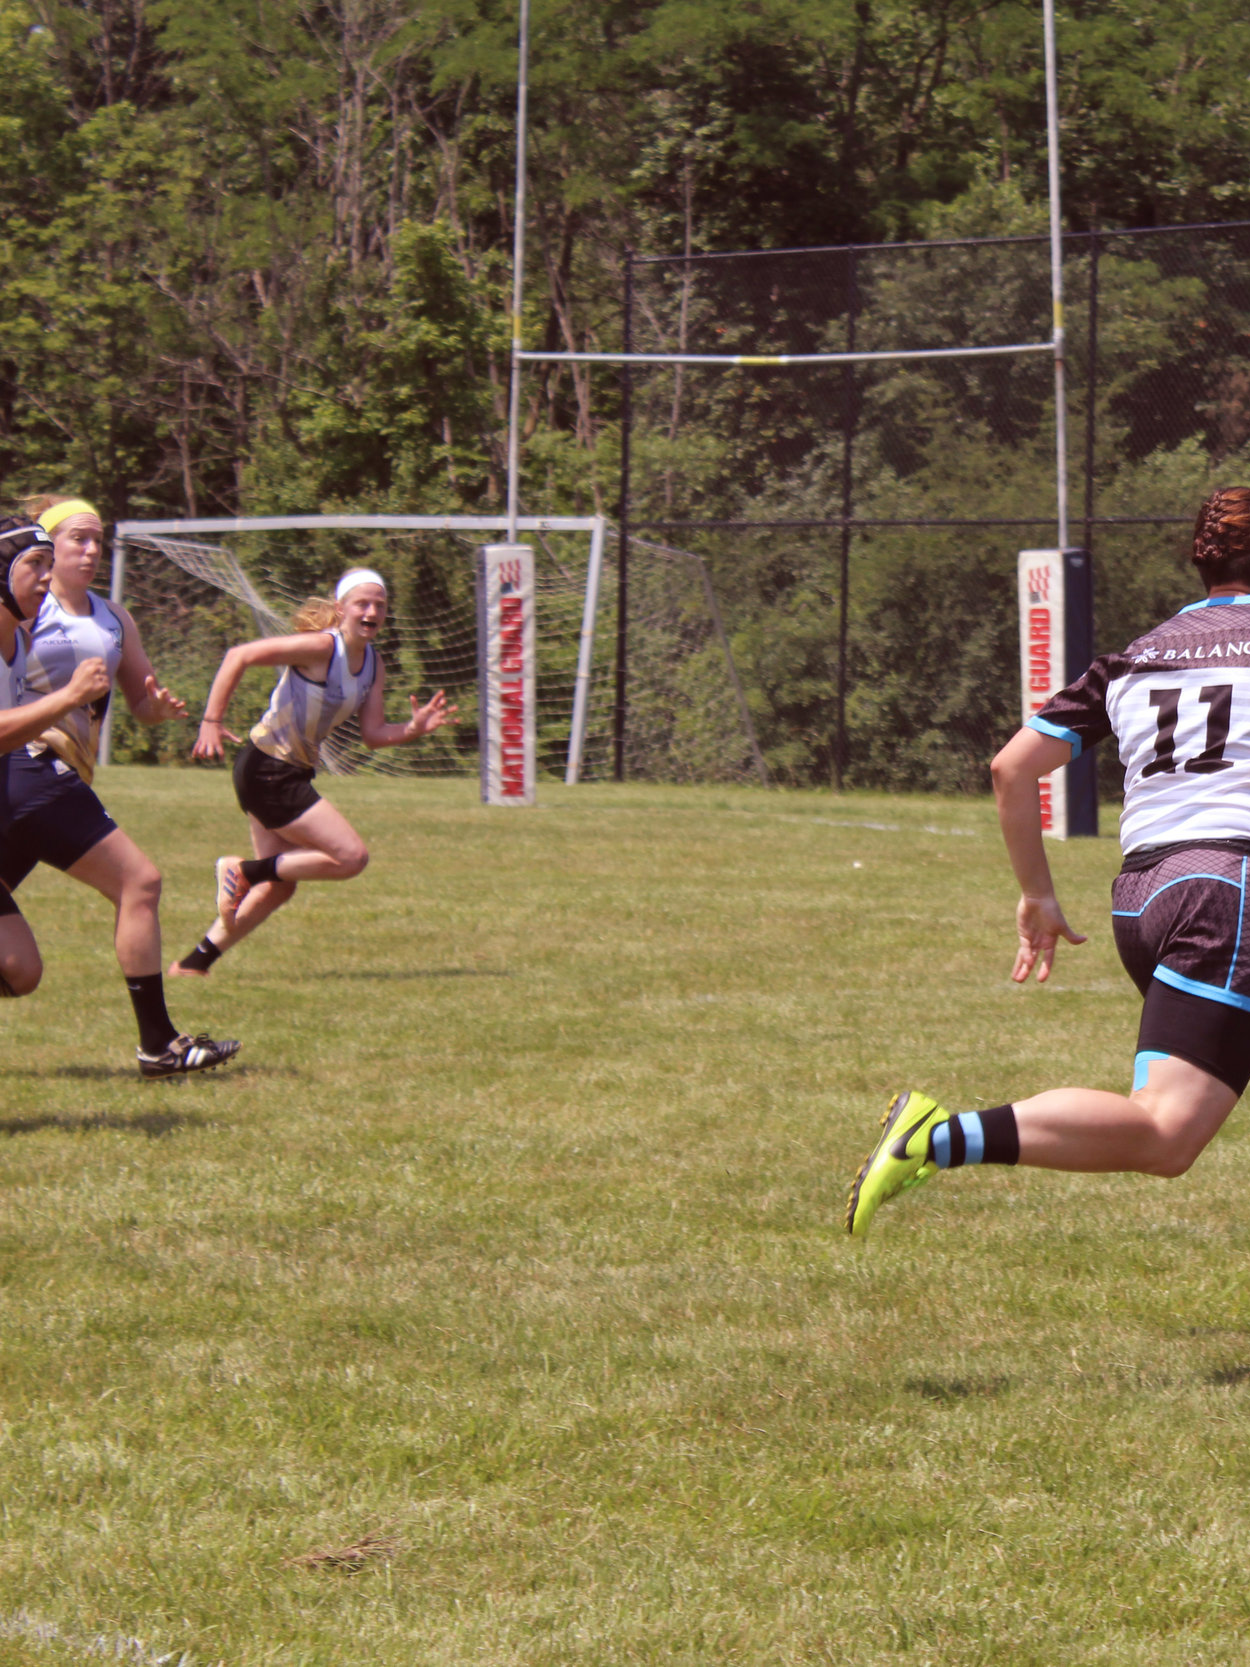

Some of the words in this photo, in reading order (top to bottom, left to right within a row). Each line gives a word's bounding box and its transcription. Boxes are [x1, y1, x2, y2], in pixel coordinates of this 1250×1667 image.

[499, 597, 524, 674] GUARD
[1028, 607, 1051, 693] GUARD
[500, 677, 525, 798] NATIONAL
[1141, 684, 1235, 778] 11
